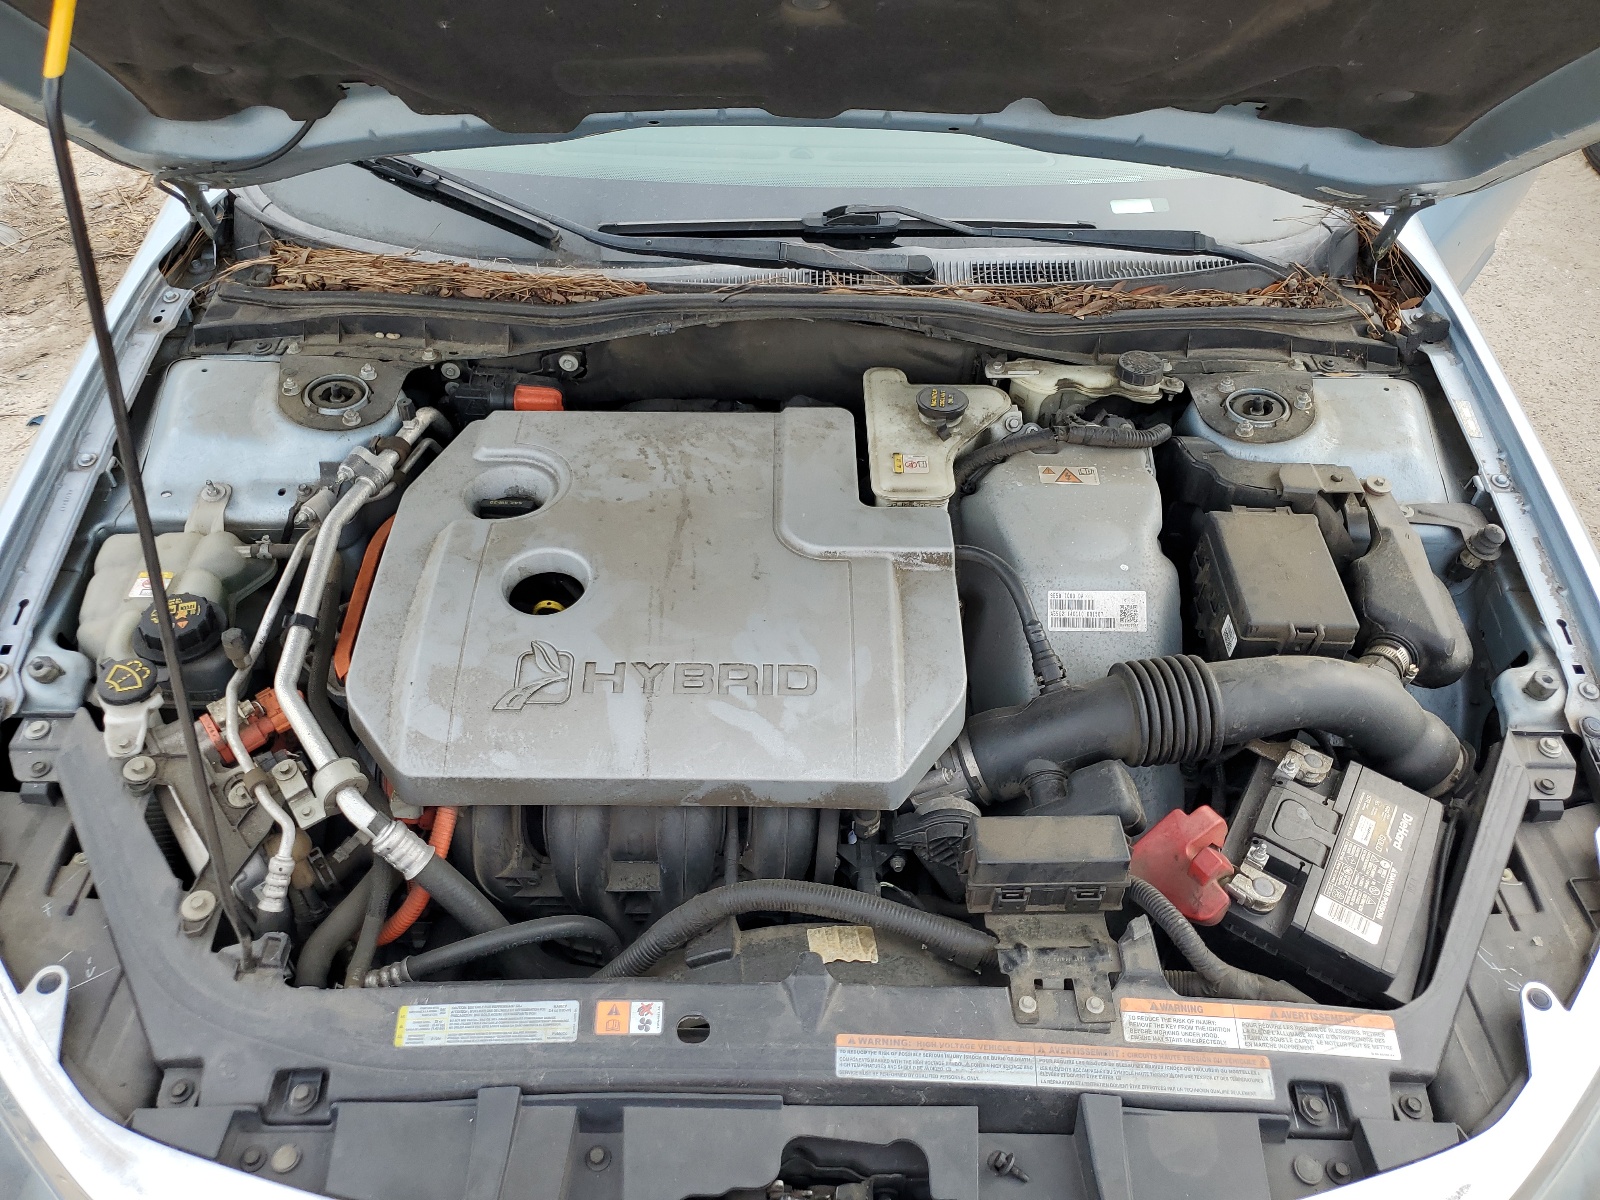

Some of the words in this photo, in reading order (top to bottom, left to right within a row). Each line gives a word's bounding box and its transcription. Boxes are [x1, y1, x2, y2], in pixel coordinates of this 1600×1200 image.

[582, 661, 818, 696] HYBRID
[1393, 812, 1414, 852] DieHard
[1375, 834, 1387, 853] GOLD
[1160, 1003, 1203, 1013] WARNING
[1281, 1011, 1356, 1023] AVERTISSEMENT
[858, 1037, 912, 1046] WARNING:
[940, 1042, 976, 1050] VOLTAGE
[978, 1044, 1012, 1052] VEHICLE
[1049, 1046, 1119, 1058] AVERTISSEMENT
